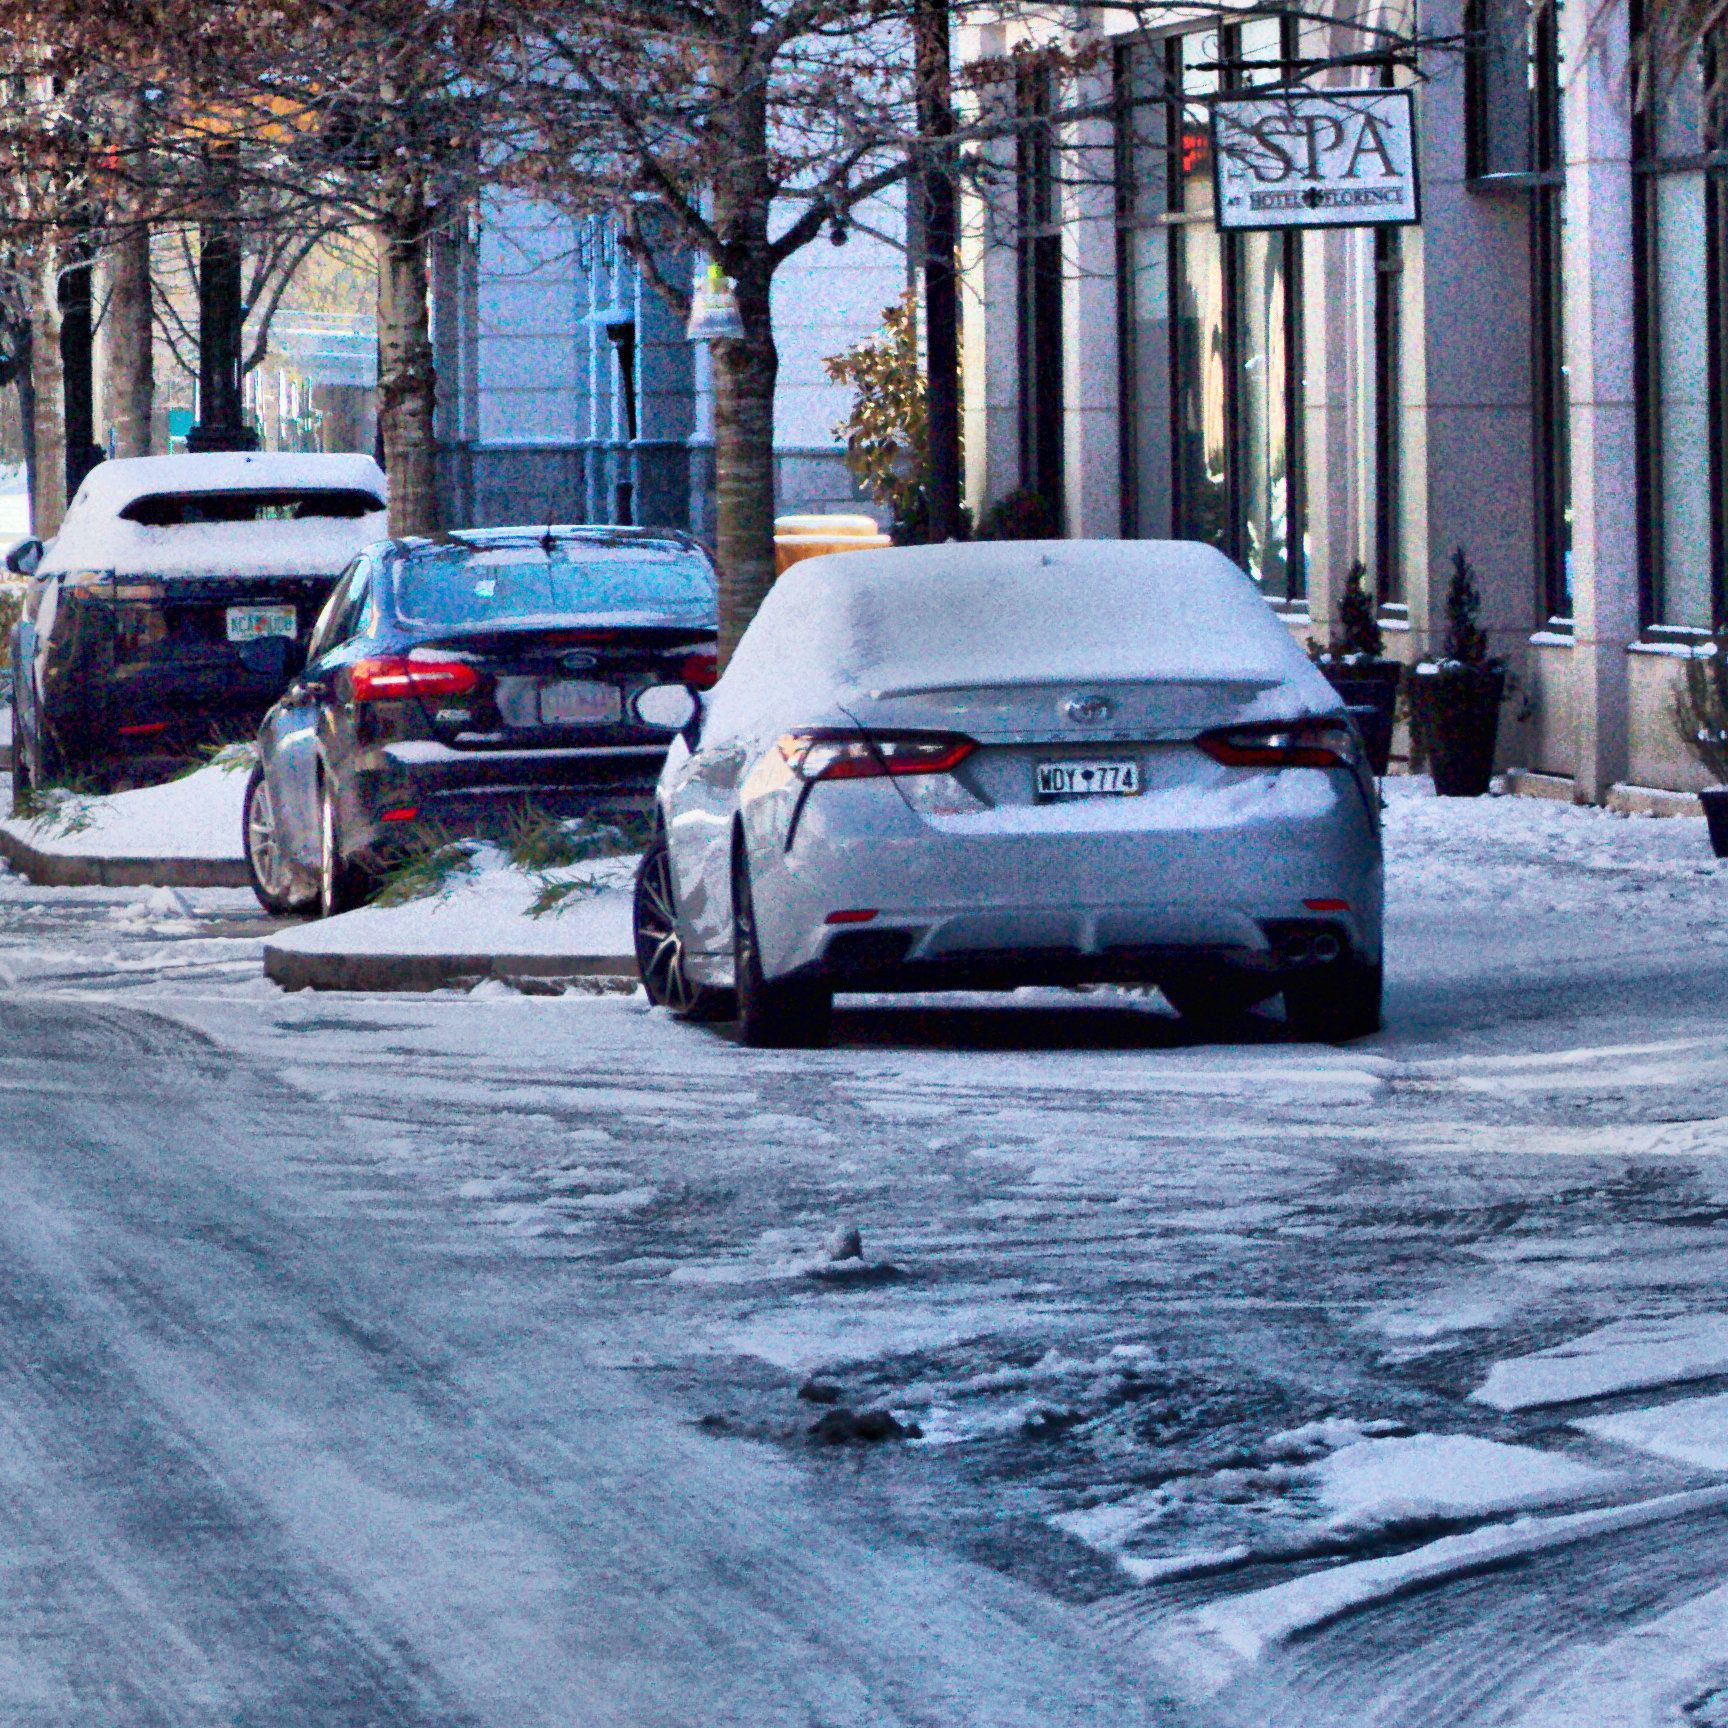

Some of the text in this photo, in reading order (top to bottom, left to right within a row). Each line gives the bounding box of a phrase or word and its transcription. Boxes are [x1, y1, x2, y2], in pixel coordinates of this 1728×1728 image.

[1253, 113, 1403, 182] SPA
[1250, 192, 1299, 208] HOTEL
[1325, 188, 1402, 206] FLORENCE
[1097, 767, 1132, 788] 774
